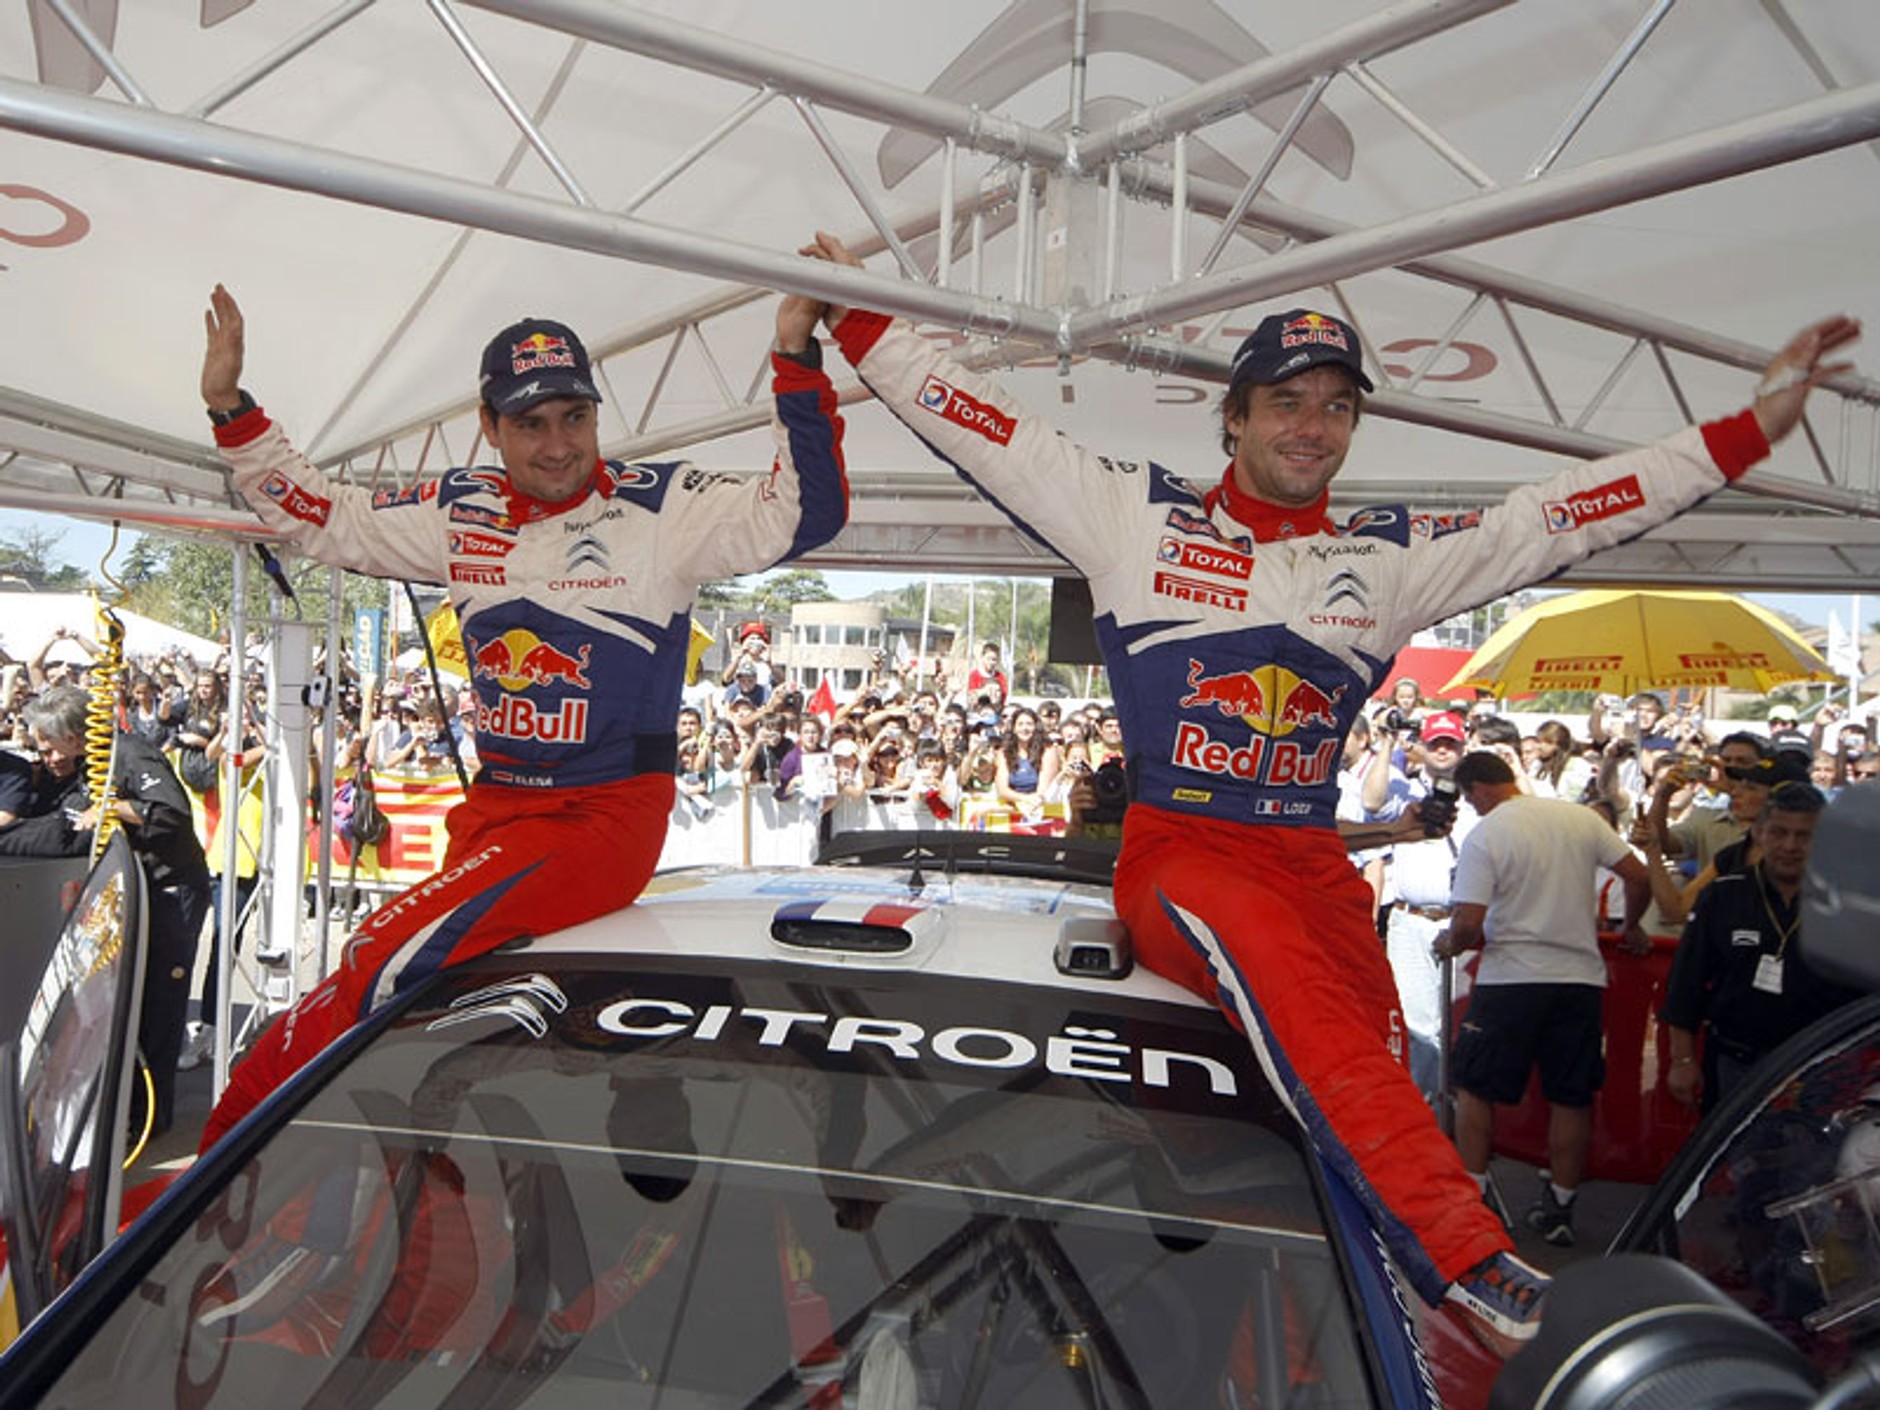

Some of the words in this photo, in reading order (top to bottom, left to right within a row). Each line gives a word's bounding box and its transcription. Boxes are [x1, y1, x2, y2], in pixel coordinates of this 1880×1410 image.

[953, 396, 1008, 438] TOTAL
[1570, 489, 1639, 517] TOTAL
[464, 535, 506, 554] TOTAL
[449, 561, 507, 587] PIRELLI
[1185, 546, 1248, 575] TOTAL
[1153, 571, 1250, 613] PIRELLI
[1535, 655, 1624, 673] PIRELLI
[508, 697, 589, 744] Bull
[1172, 720, 1267, 782] Red
[1265, 737, 1341, 787] Bull
